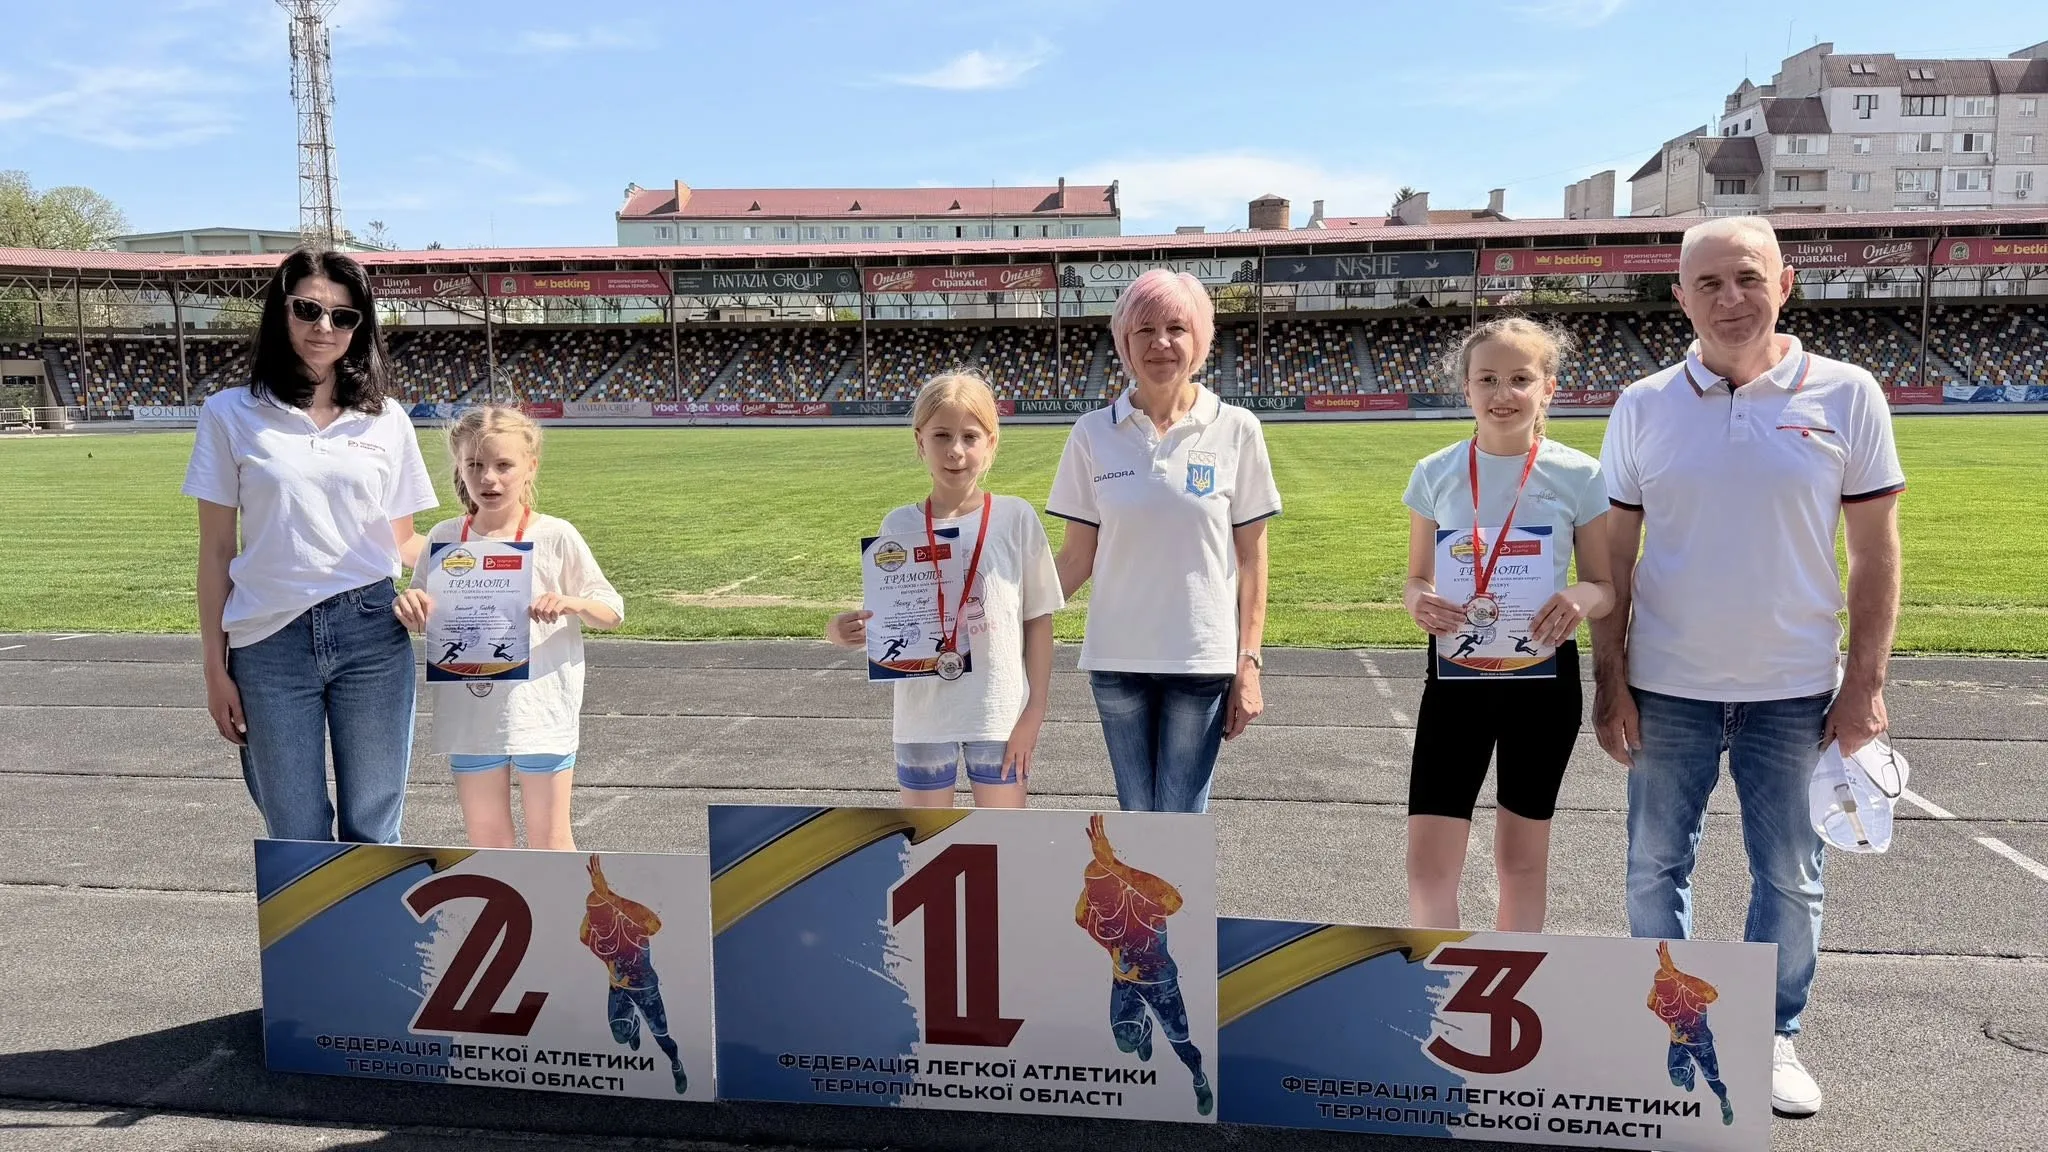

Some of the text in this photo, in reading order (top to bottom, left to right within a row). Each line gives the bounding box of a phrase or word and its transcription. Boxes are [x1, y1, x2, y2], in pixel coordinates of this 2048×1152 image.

[1798, 244, 1833, 255] Цінуй
[1862, 242, 1913, 262] Опілля
[2013, 244, 2048, 255] betki
[1554, 254, 1603, 267] betking
[1782, 252, 1848, 265] Справжнє!
[1335, 255, 1401, 280] NASHE
[945, 269, 976, 280] Цінуй
[550, 279, 591, 291] betking
[712, 273, 769, 289] FANTAZIA
[772, 272, 824, 291] GROUP
[653, 403, 679, 412] vbet
[684, 403, 710, 412] vet
[715, 403, 740, 412] vbet
[1021, 400, 1101, 413] FANTAZIA GROUP
[1222, 397, 1297, 410] NTAZIA GROUP
[1327, 398, 1360, 408] betking
[139, 406, 201, 417] CONTIN
[1093, 469, 1136, 483] DIADORA
[883, 569, 943, 585] ГРАМОТА
[448, 578, 512, 590] ГРАМОТА
[891, 842, 1025, 1049] 1
[404, 873, 550, 1037] 2
[1425, 946, 1549, 1075] 3
[315, 1034, 655, 1072] ФЕДЕРАЦІЯ ЛЕГКОЇ АТЛЕТИКИ
[345, 1057, 625, 1092] ТЕРНОПІЛЬСЬКОЇ ОБЛАСТІ
[778, 1052, 1158, 1086] ФЕДЕРАЦІЯ ЛЕГКОЇ АТЛЕТИКИ
[810, 1076, 1123, 1107] ТЕРНОПІЛЬСЬКОЇ ОБЛАСТІ
[1281, 1075, 1702, 1118] ФЕДЕРАЦІЯ ЛЕГКОЇ АТЛЕТИКИ
[1315, 1101, 1663, 1140] ТЕРНОПІЛЬСЬКОЇ ОБЛАСТІ
